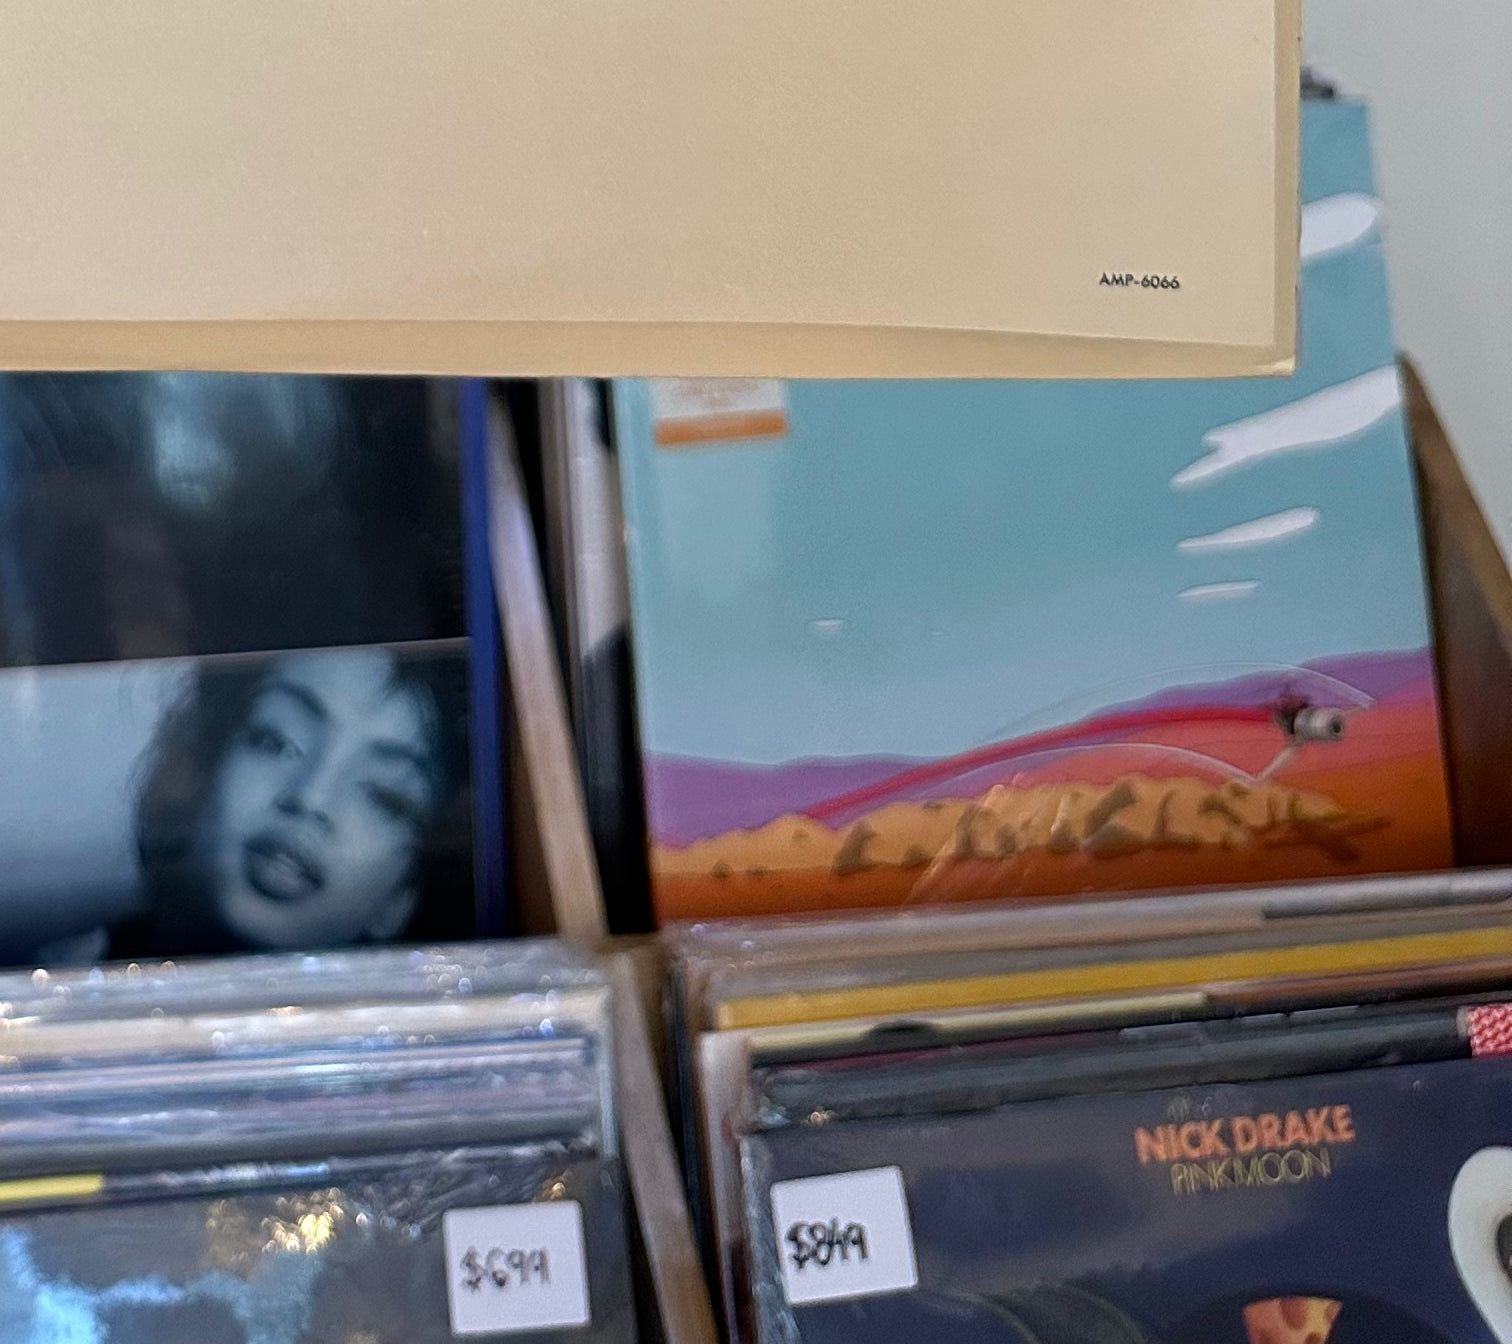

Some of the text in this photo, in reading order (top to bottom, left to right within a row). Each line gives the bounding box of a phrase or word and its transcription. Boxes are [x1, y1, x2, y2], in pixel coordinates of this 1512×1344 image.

[1099, 272, 1181, 289] AMP-6066
[1135, 1104, 1355, 1165] NICK DRAKE
